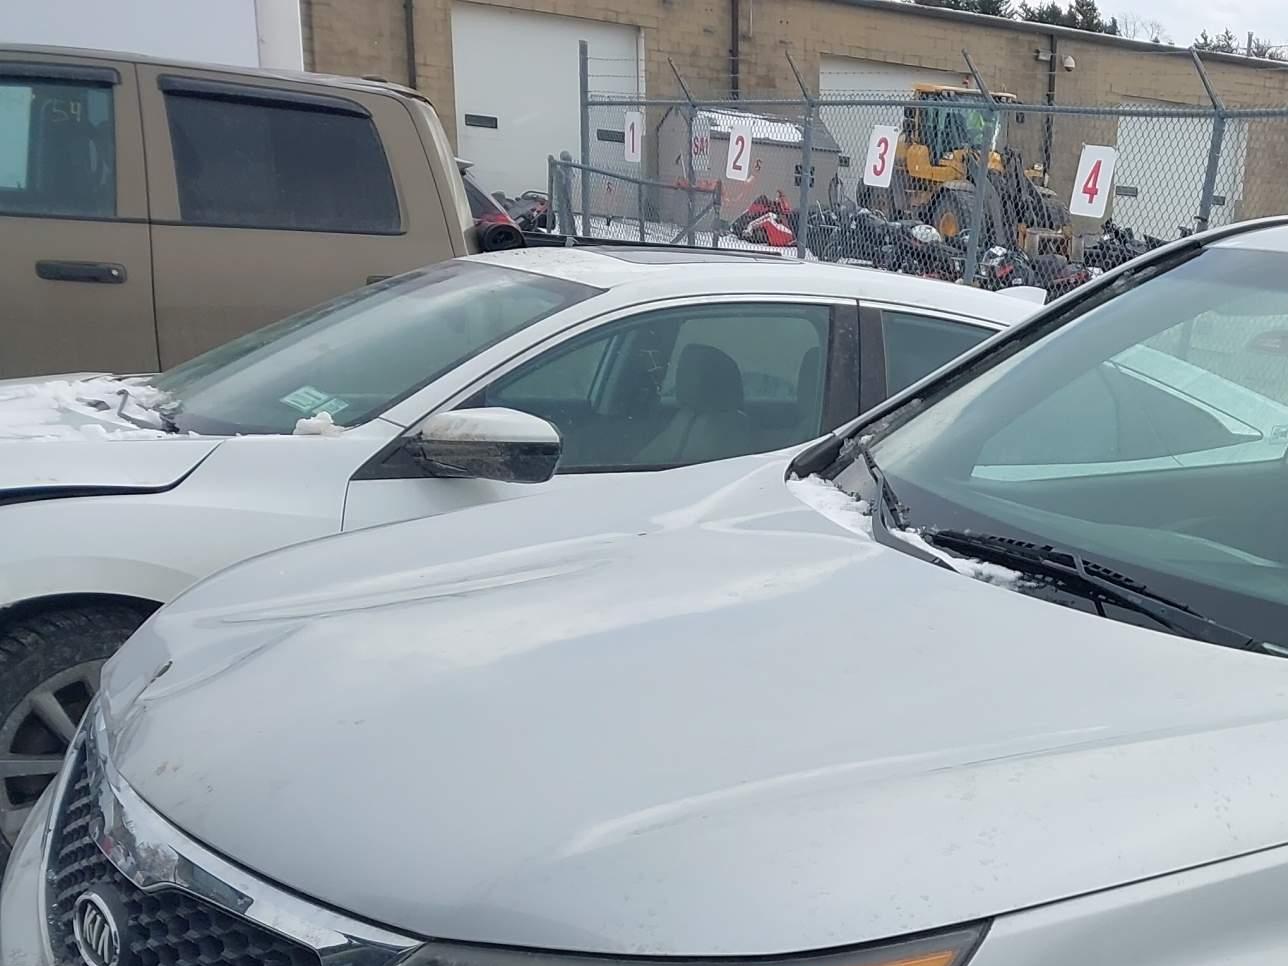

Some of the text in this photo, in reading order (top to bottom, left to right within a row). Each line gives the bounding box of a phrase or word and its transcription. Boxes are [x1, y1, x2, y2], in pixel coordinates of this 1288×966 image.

[629, 122, 636, 154] 1
[732, 135, 745, 171] 2
[872, 137, 889, 177] 3
[1081, 159, 1103, 204] 4
